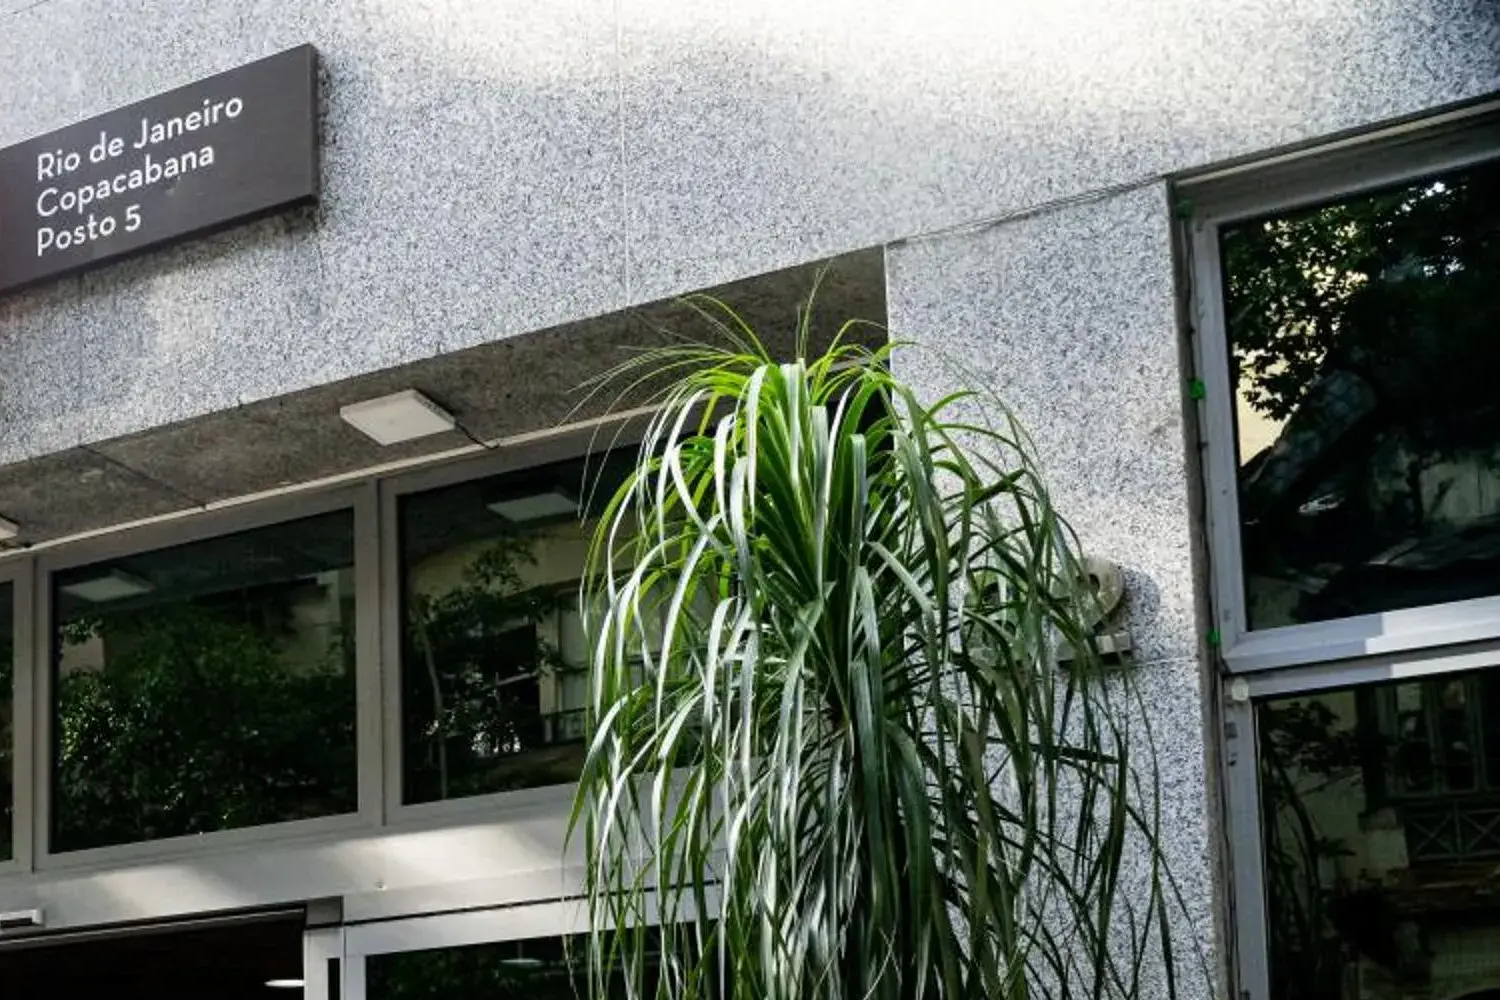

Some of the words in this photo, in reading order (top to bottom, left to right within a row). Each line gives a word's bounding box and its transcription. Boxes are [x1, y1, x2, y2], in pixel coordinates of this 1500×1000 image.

[36, 149, 81, 182] Rio
[89, 131, 125, 163] de
[133, 97, 244, 150] Janeiro
[36, 145, 216, 217] Copacabana
[36, 214, 117, 257] Posto
[124, 203, 142, 232] 5
